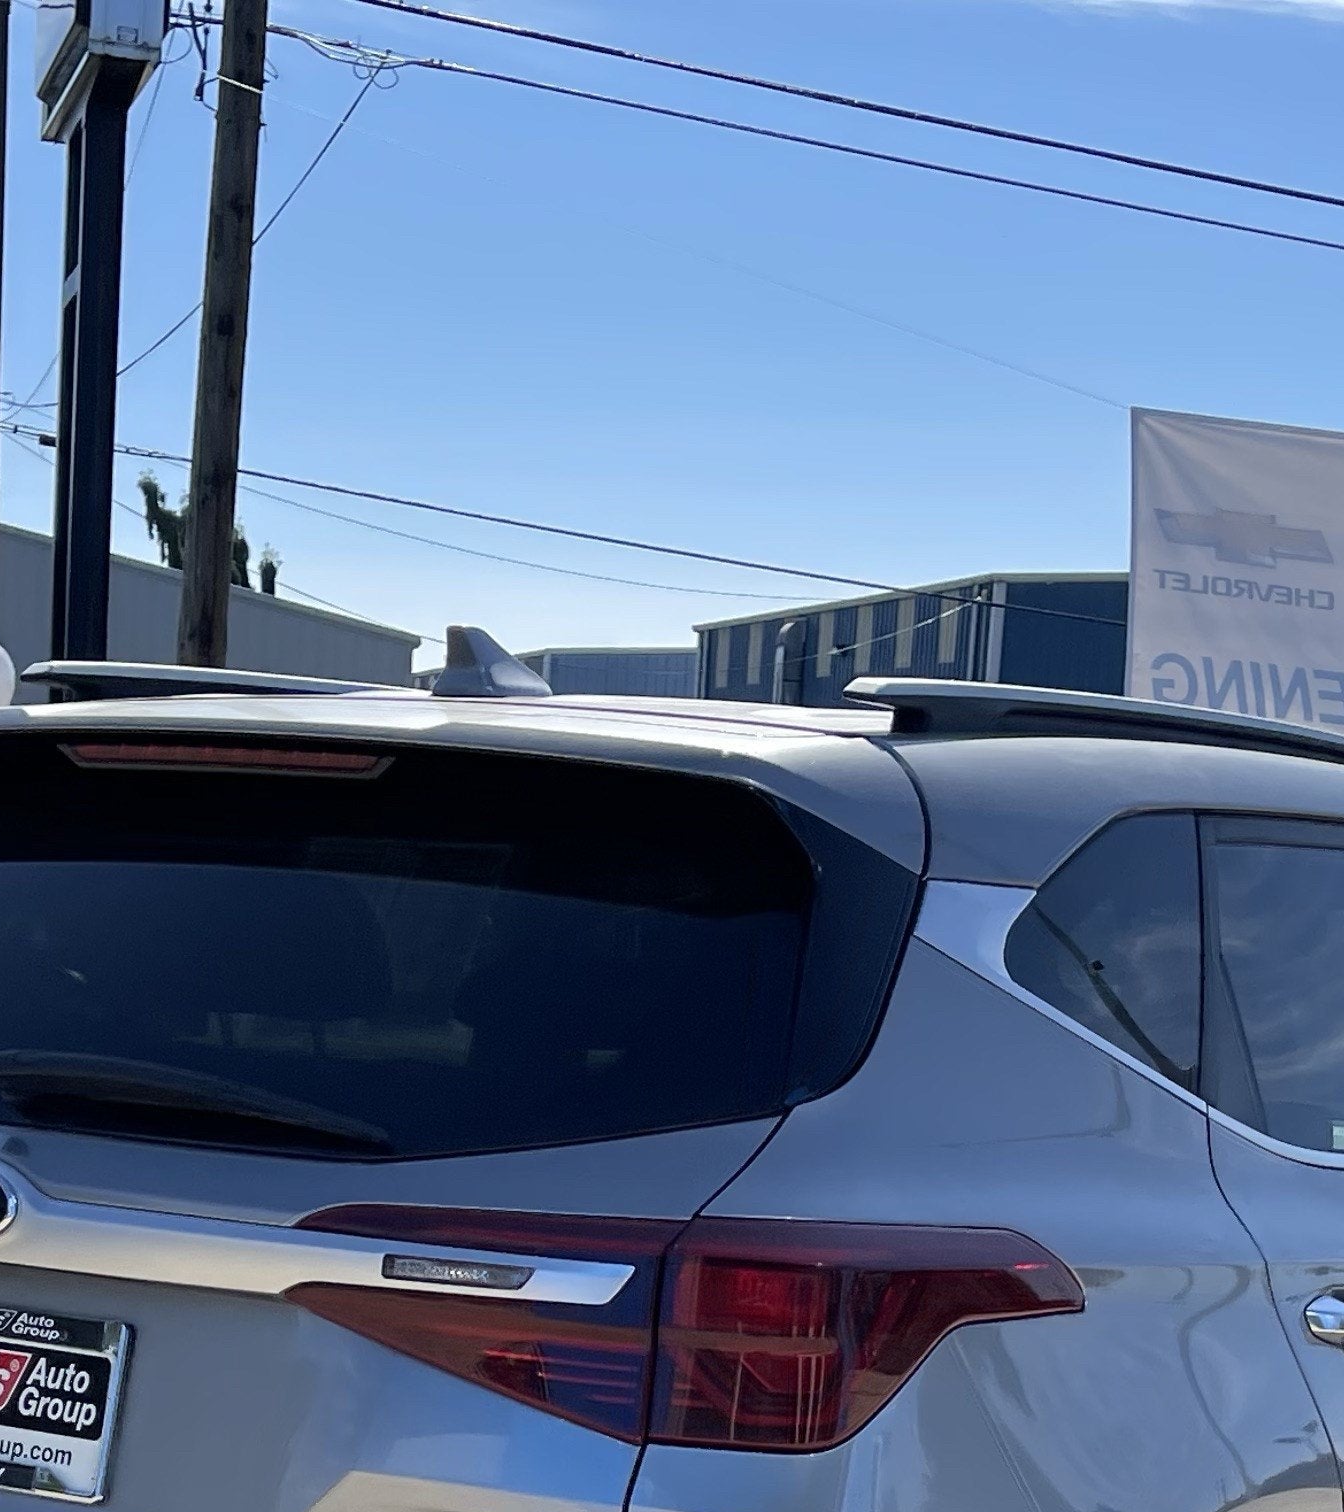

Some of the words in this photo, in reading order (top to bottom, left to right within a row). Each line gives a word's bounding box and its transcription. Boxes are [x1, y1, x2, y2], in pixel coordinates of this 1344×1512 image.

[11, 1322, 60, 1342] Group
[16, 1313, 55, 1329] Auto
[26, 1357, 91, 1395] Auto
[18, 1386, 98, 1431] Group
